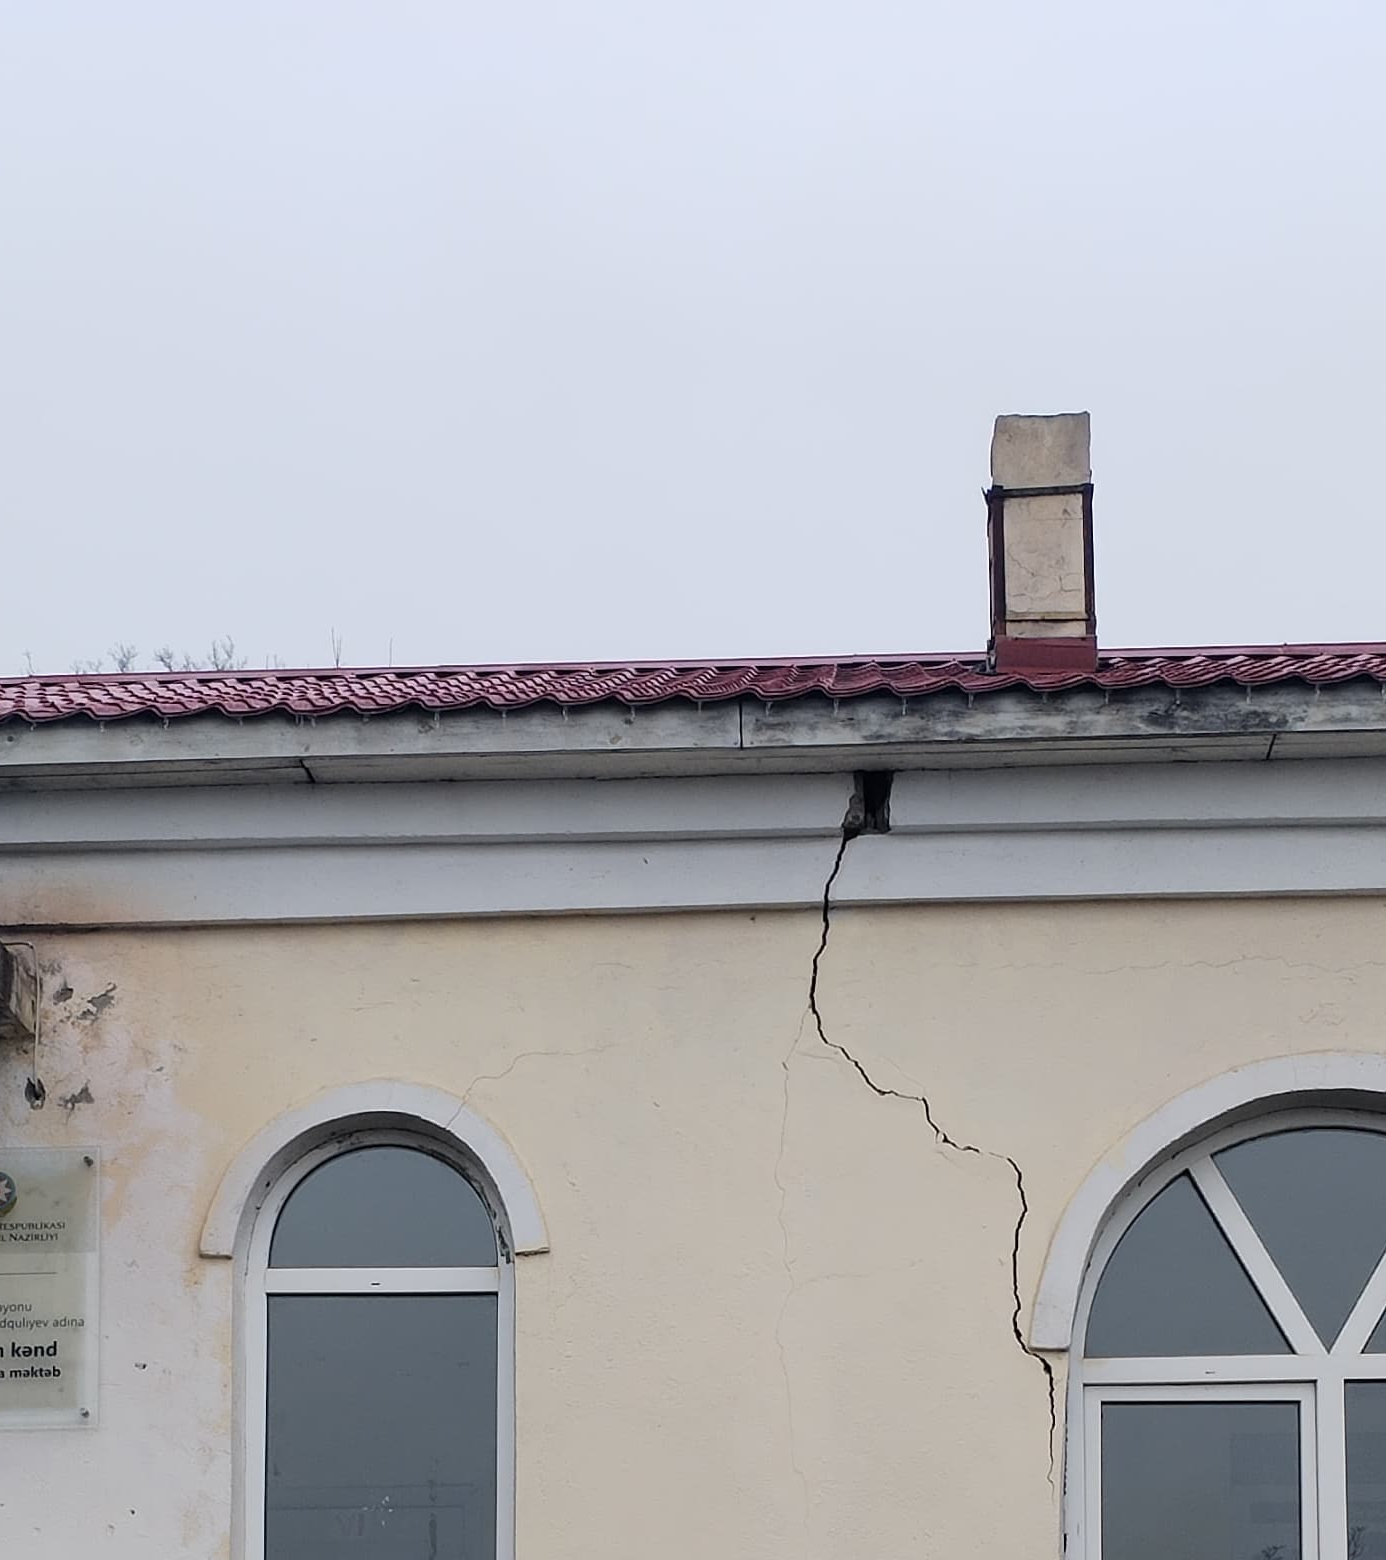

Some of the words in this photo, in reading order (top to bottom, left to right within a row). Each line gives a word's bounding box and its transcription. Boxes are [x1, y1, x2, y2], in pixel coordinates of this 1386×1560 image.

[52, 1316, 85, 1328] adına
[11, 1340, 58, 1358] kənd
[9, 1366, 62, 1379] məktəb
